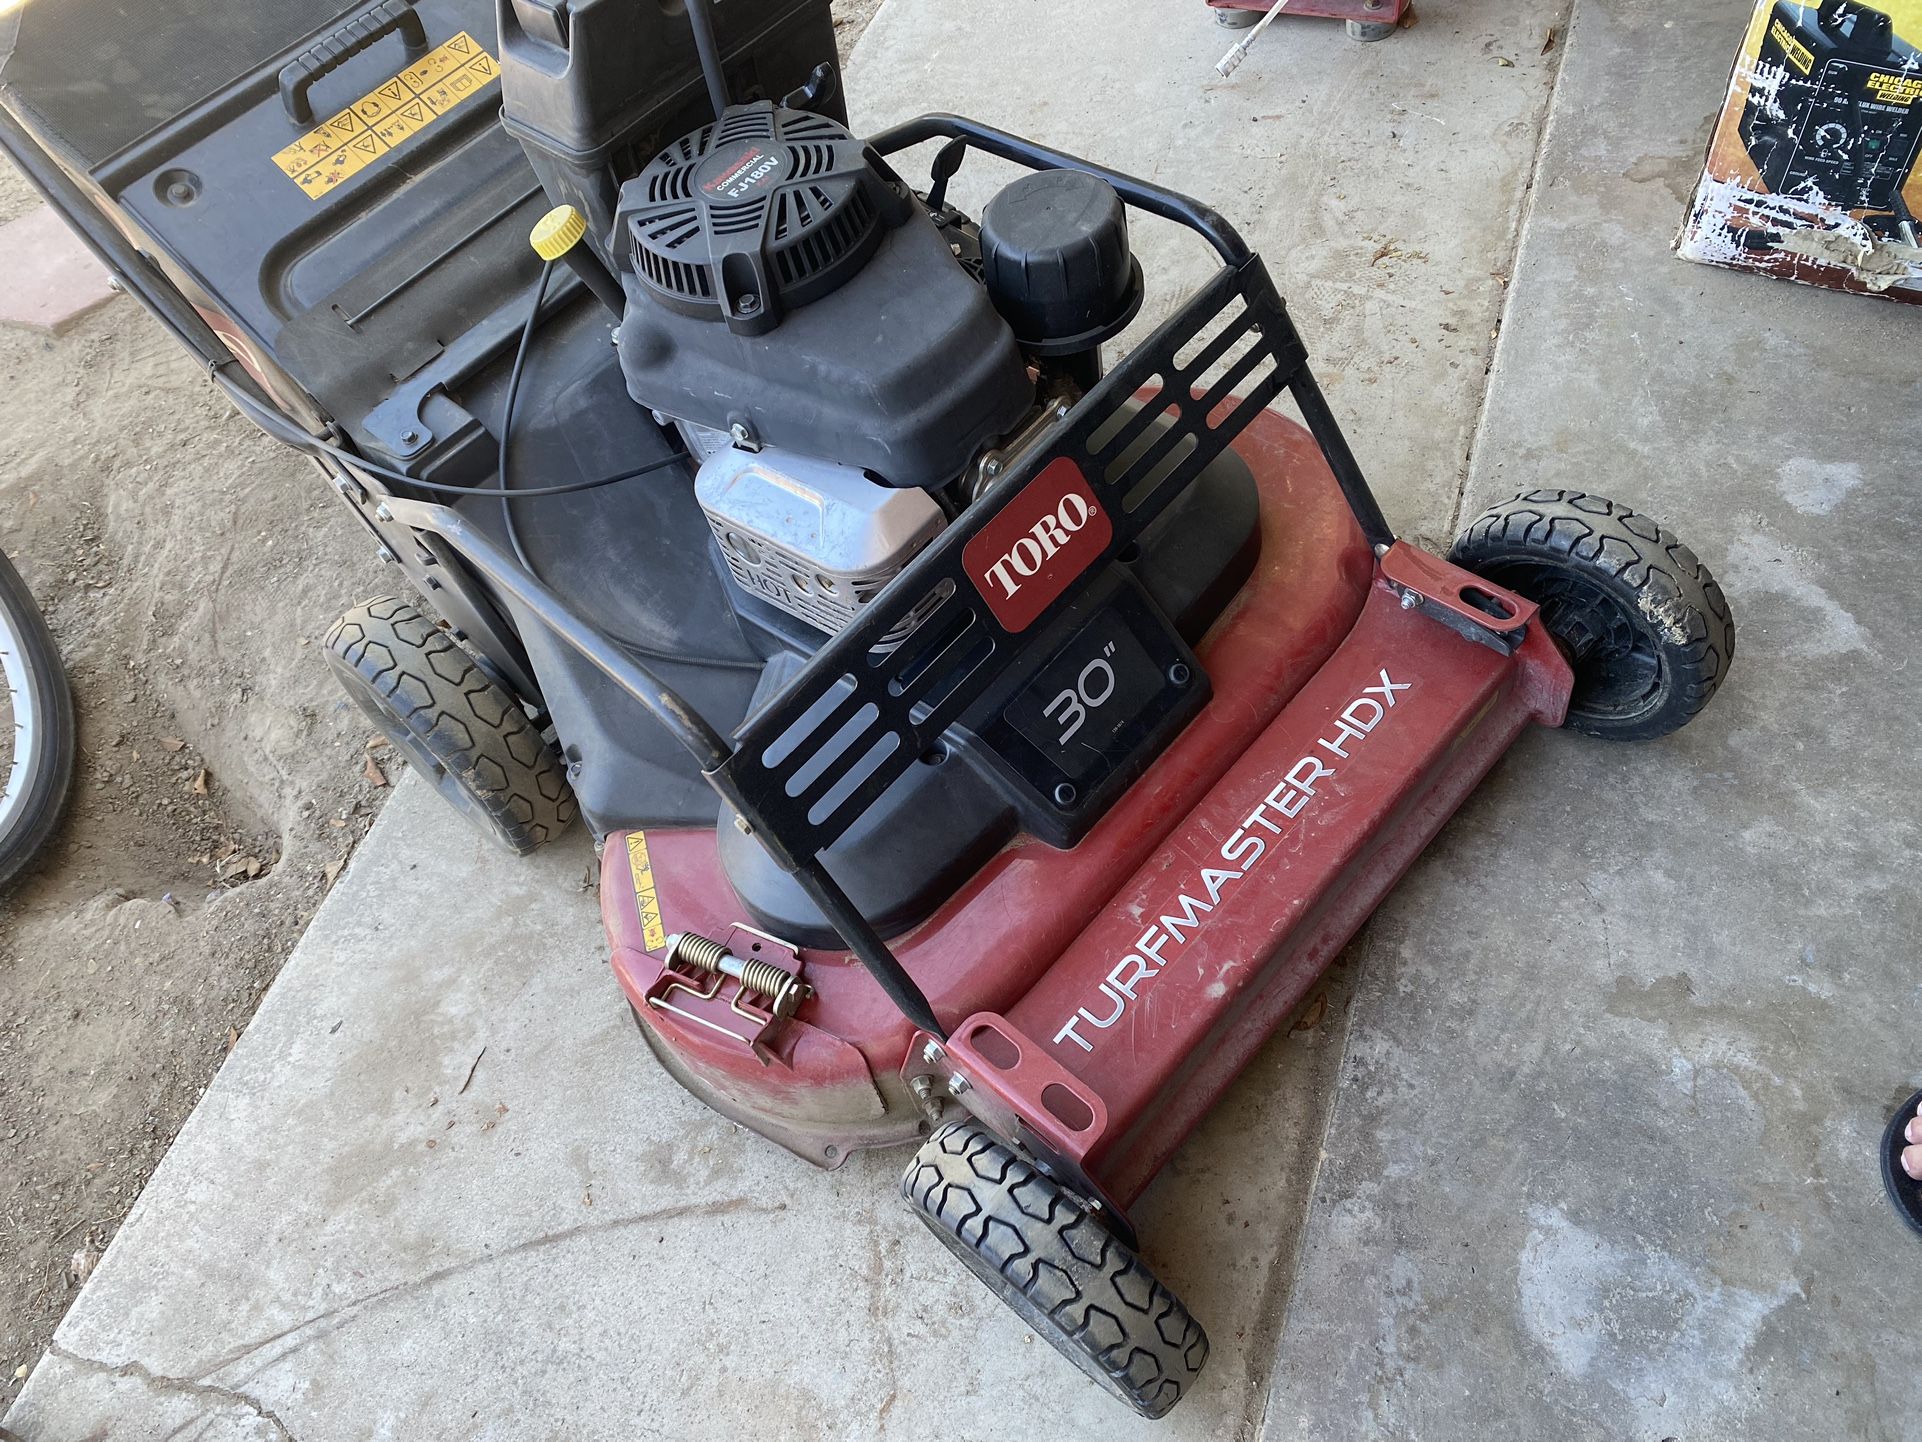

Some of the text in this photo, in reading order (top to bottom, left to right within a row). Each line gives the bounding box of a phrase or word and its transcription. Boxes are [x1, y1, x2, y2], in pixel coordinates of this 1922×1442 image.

[1790, 44, 1812, 70] WELDING
[1866, 80, 1922, 97] ELECTRI
[1869, 72, 1922, 89] CHICAG
[1878, 92, 1911, 103] WELDING
[1886, 105, 1910, 115] WELDER
[716, 154, 765, 191] COMMERCIAL
[727, 156, 779, 198] FJ180V
[984, 492, 1089, 601] TORO
[746, 569, 792, 604] HOT
[1042, 640, 1118, 746] 30"
[1052, 667, 1413, 1053] TURFMASTER HDX
